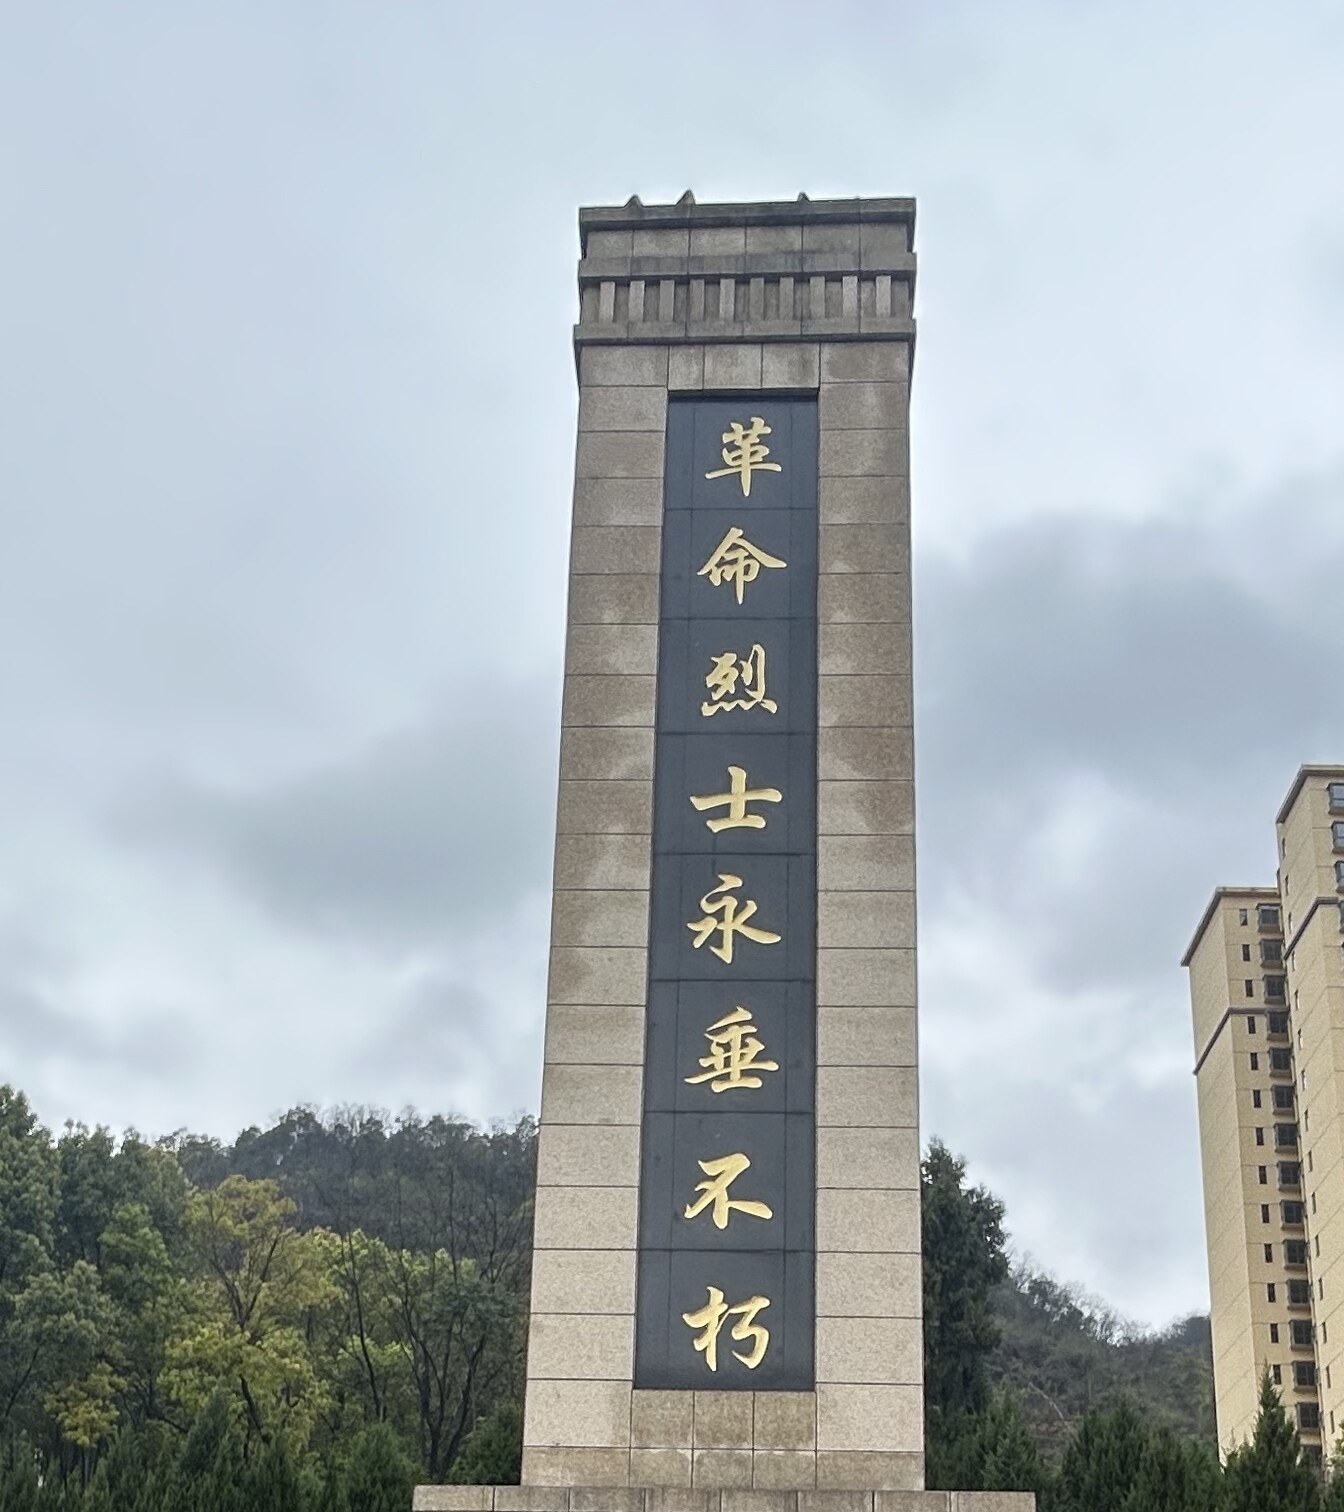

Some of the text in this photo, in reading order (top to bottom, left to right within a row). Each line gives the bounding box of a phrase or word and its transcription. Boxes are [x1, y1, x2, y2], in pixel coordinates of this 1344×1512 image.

[683, 416, 787, 1371] 革命烈士永垂不朽
